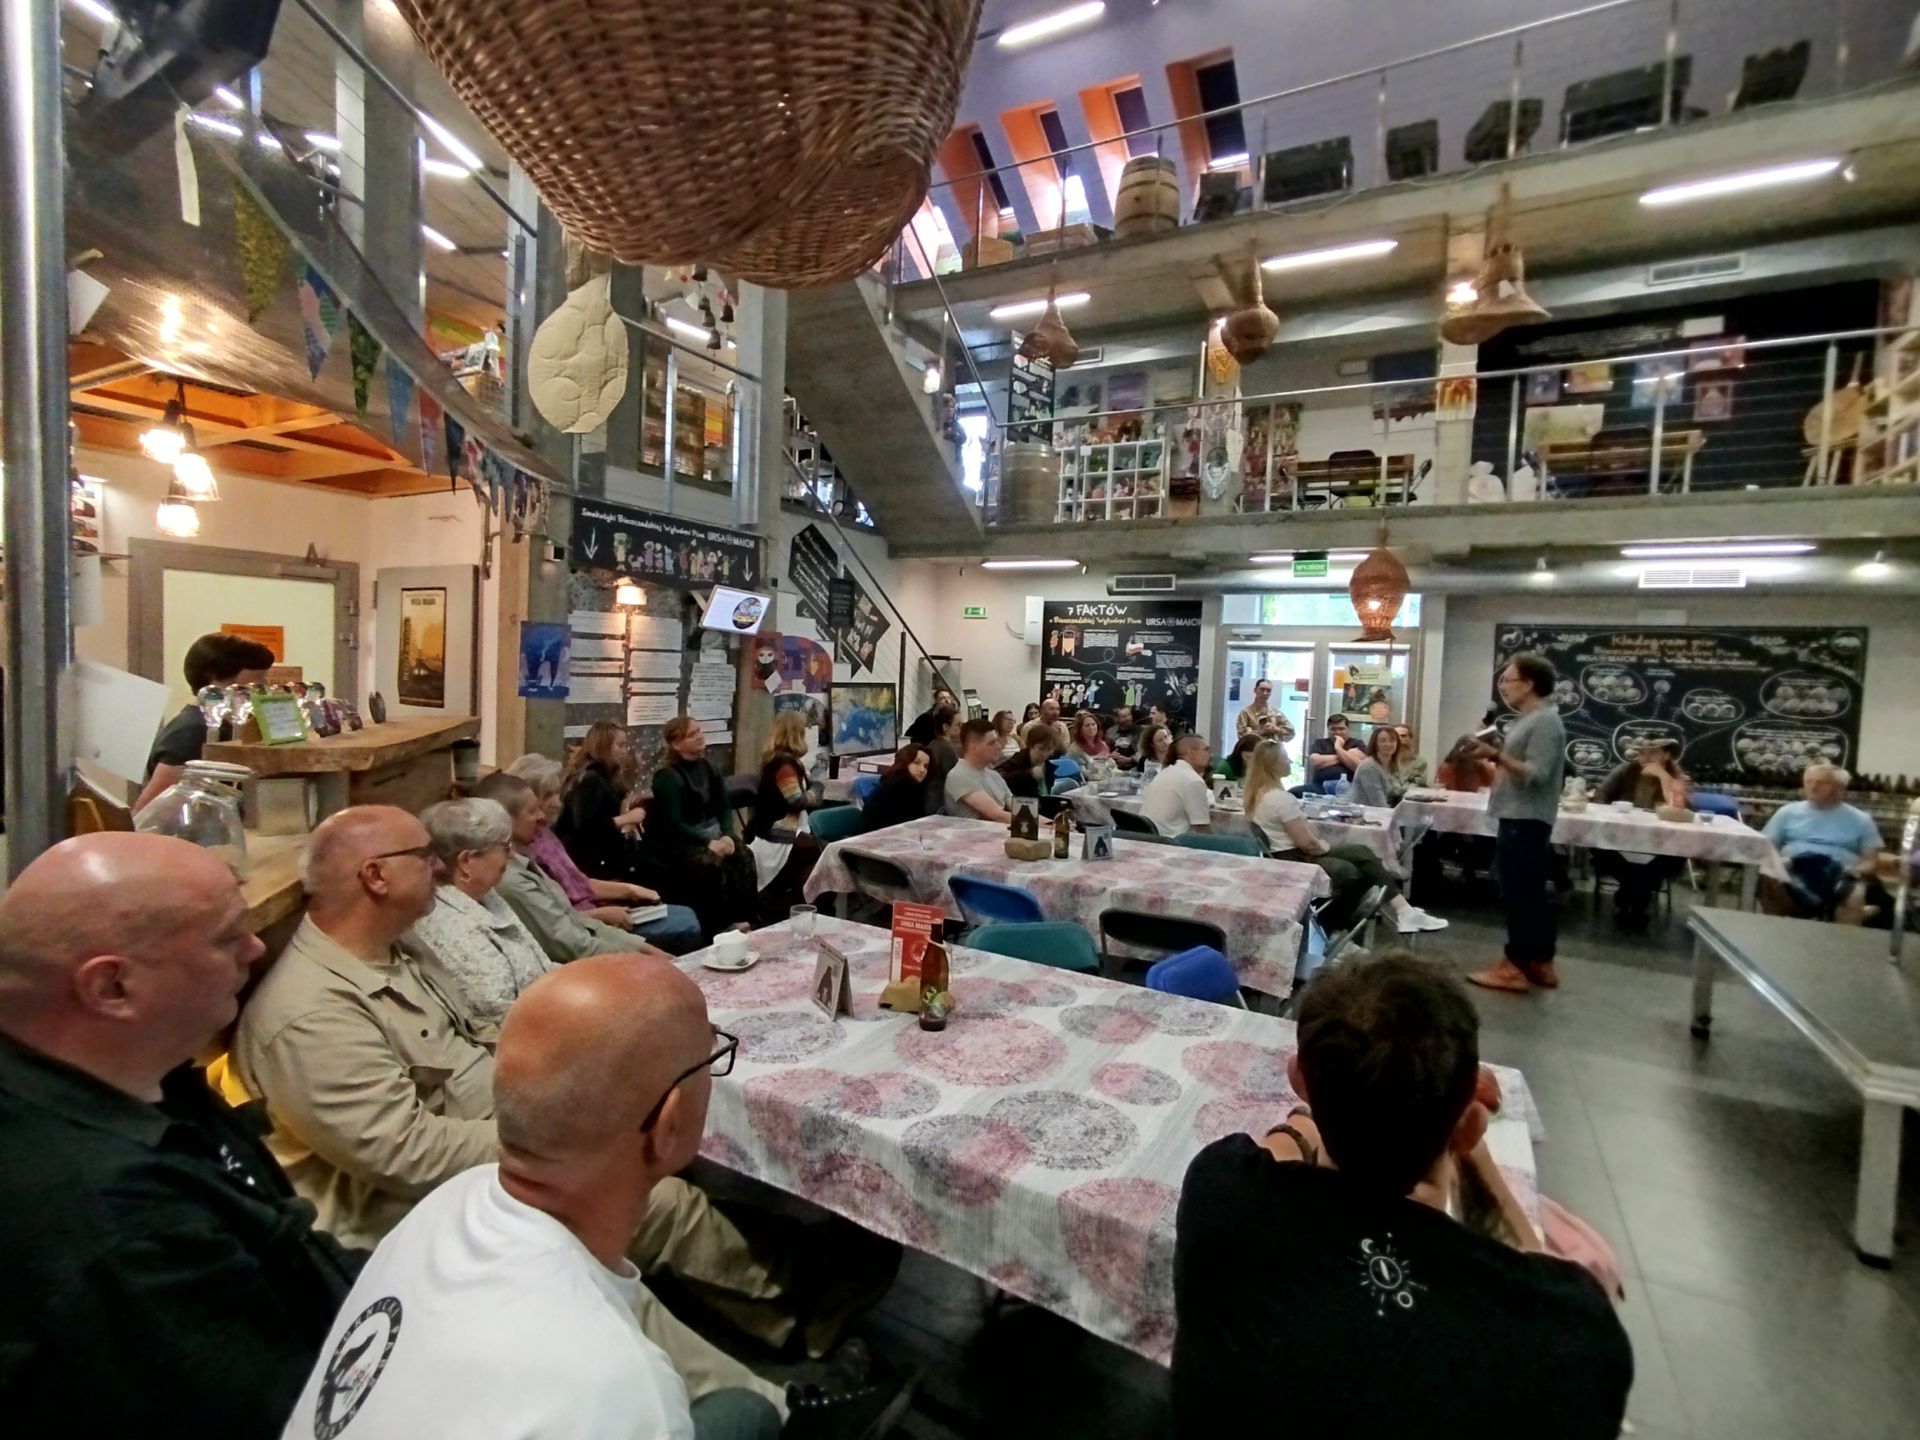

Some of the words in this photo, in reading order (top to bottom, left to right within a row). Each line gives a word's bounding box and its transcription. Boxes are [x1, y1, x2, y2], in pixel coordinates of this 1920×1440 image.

[707, 531, 725, 543] URSA
[1067, 606, 1074, 616] 7
[1076, 603, 1128, 617] FAKTÓW
[1146, 617, 1167, 626] URSA
